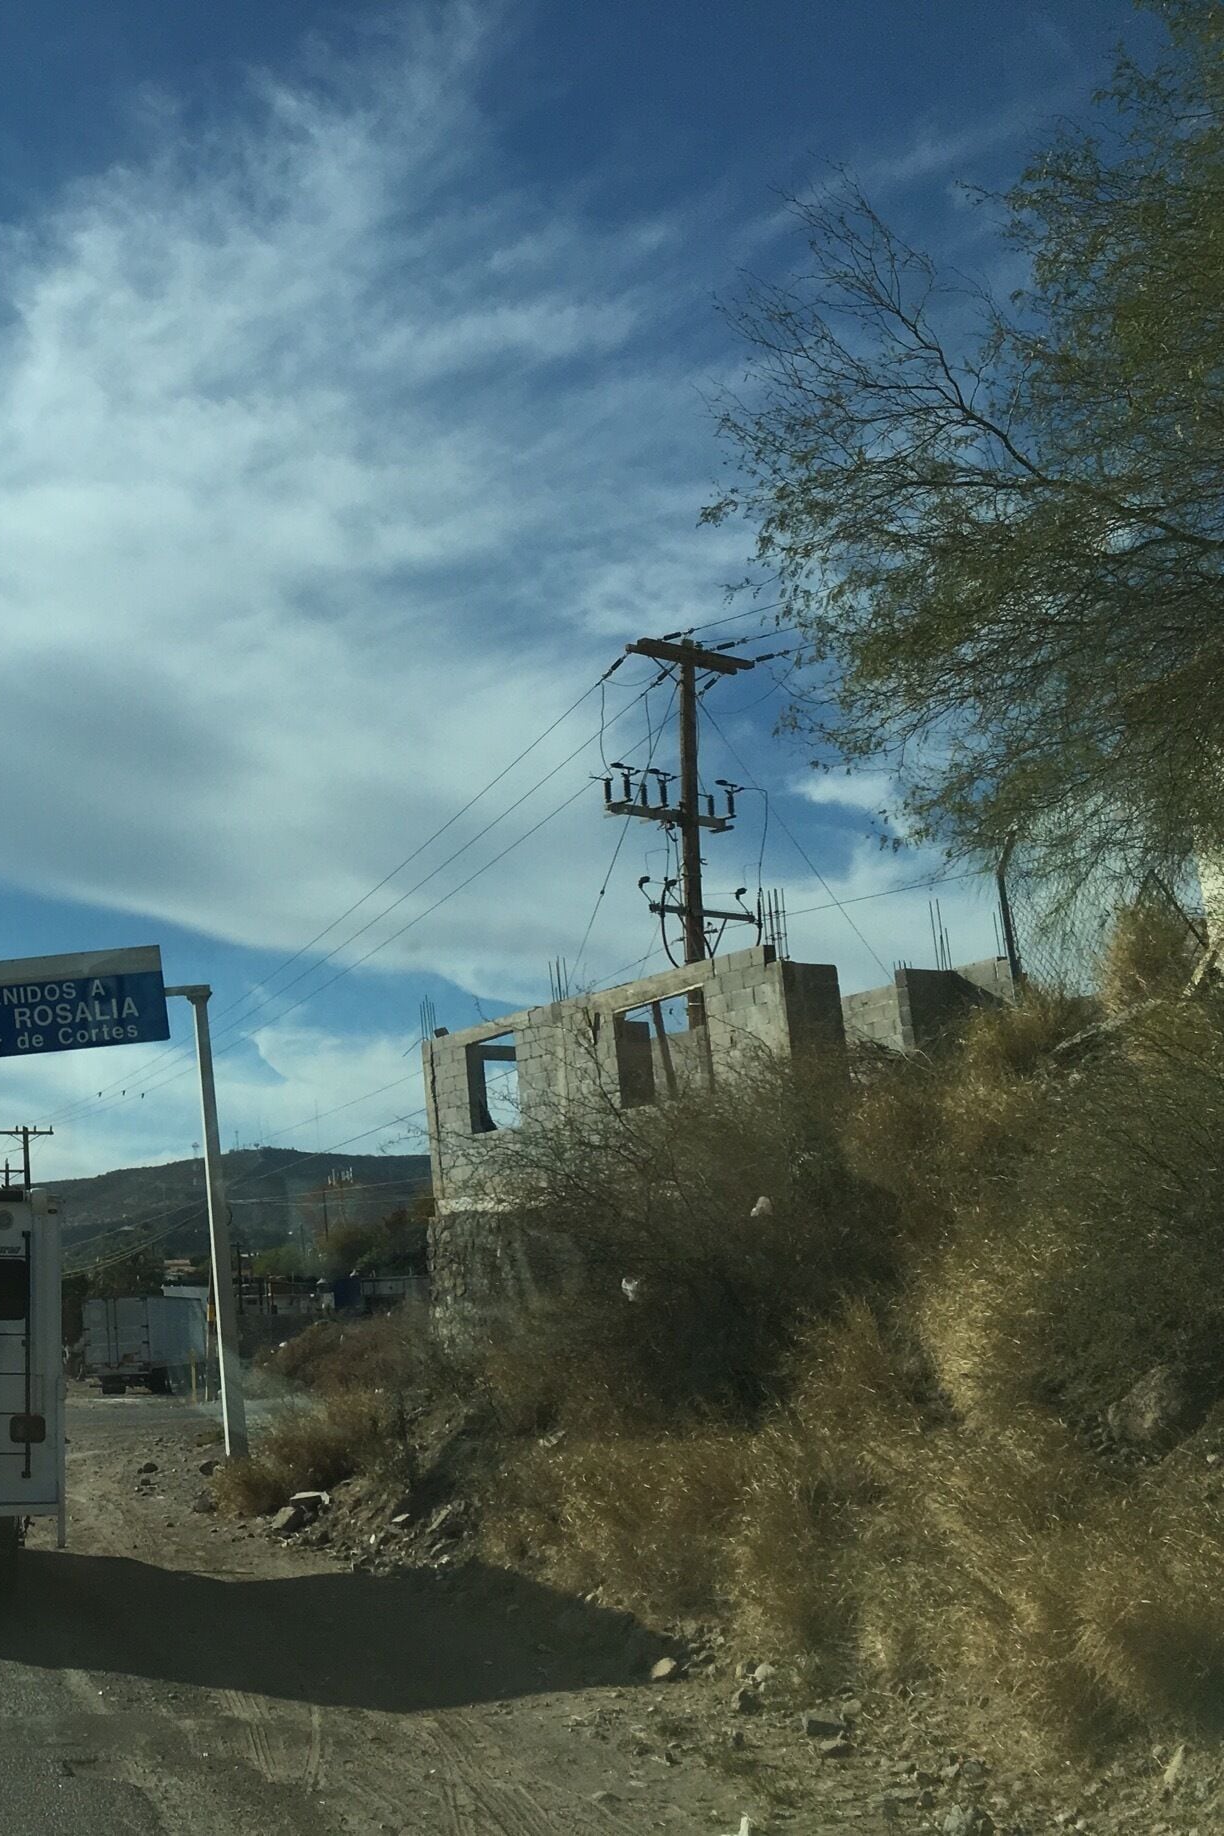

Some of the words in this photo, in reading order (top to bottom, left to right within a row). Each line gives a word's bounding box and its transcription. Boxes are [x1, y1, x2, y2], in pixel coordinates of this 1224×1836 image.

[91, 979, 106, 997] A
[14, 997, 140, 1029] ROSALIA
[17, 1032, 45, 1050] de
[58, 1024, 139, 1045] Cortes
